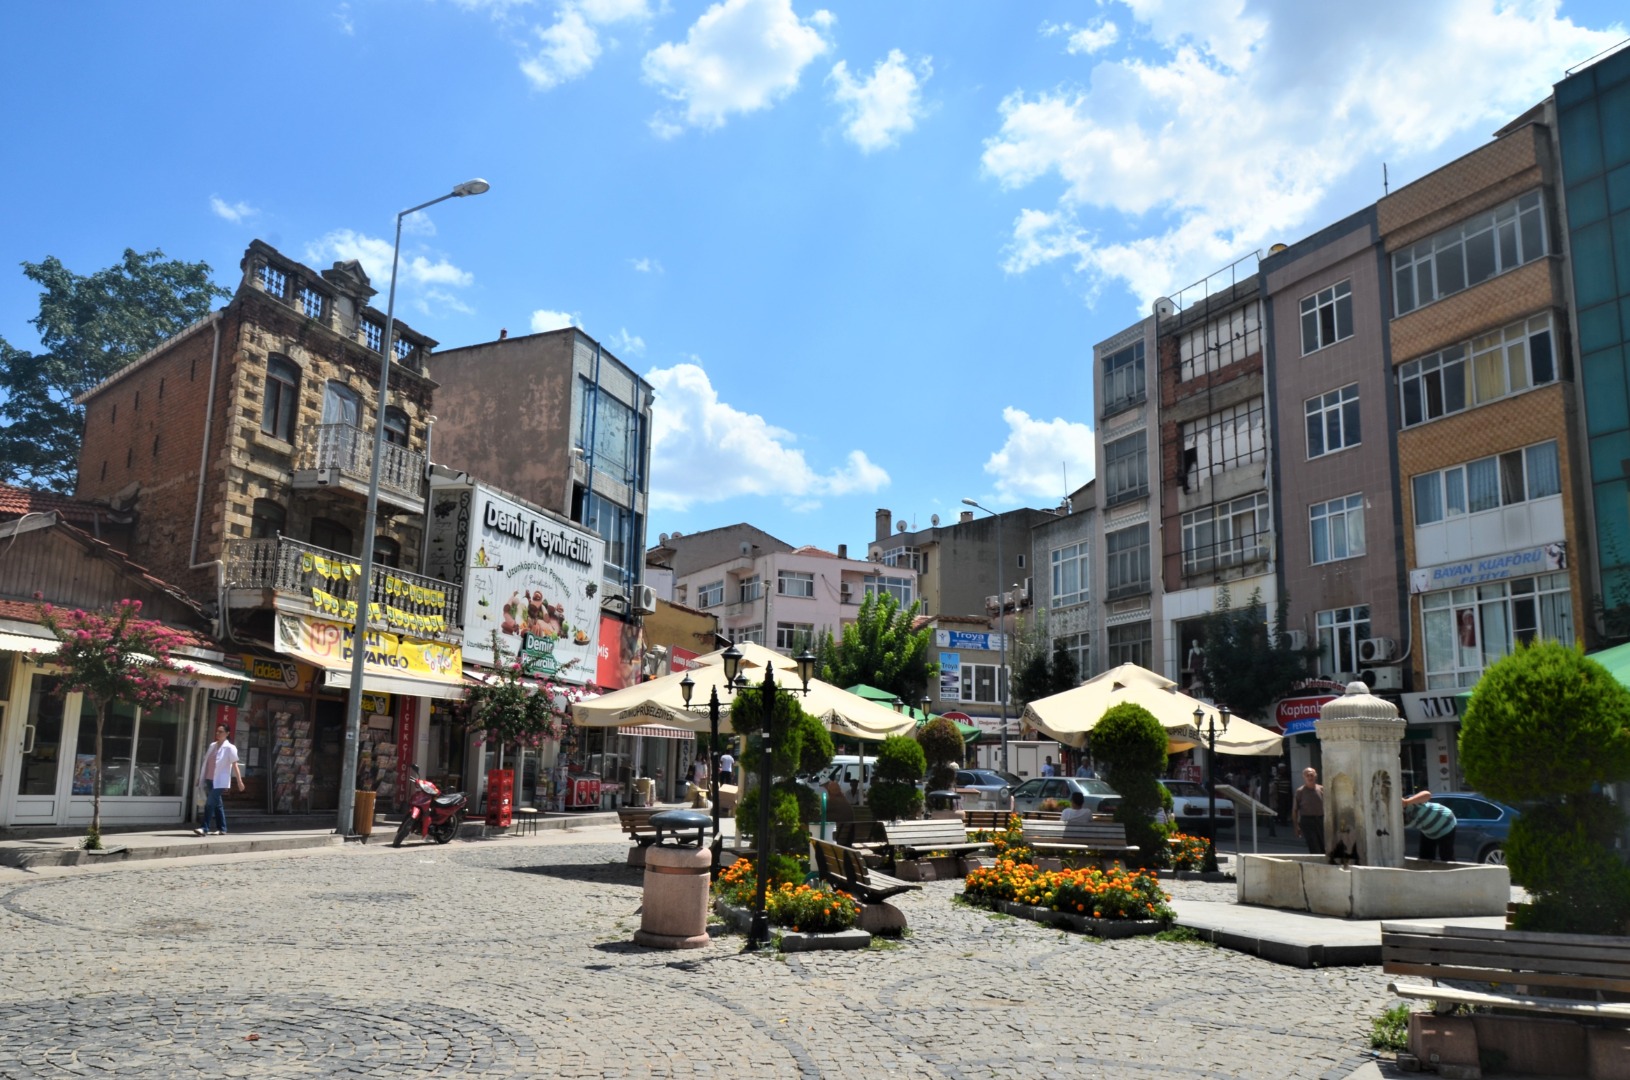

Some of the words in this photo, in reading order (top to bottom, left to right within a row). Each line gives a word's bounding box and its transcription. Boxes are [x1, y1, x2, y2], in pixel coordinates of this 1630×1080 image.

[453, 491, 469, 583] ŞARKÜTE
[485, 501, 528, 541] Demir
[530, 520, 594, 565] Peynircilik
[1433, 563, 1473, 580] BAYAN
[1478, 548, 1542, 571] KUAFÖRÜ
[527, 634, 554, 652] Demir
[956, 631, 984, 640] Troya
[597, 644, 609, 660] MİŞ
[254, 661, 282, 679] iddaa
[942, 662, 958, 670] Troya
[1280, 700, 1321, 718] Kaptanb
[1419, 696, 1458, 718] MU
